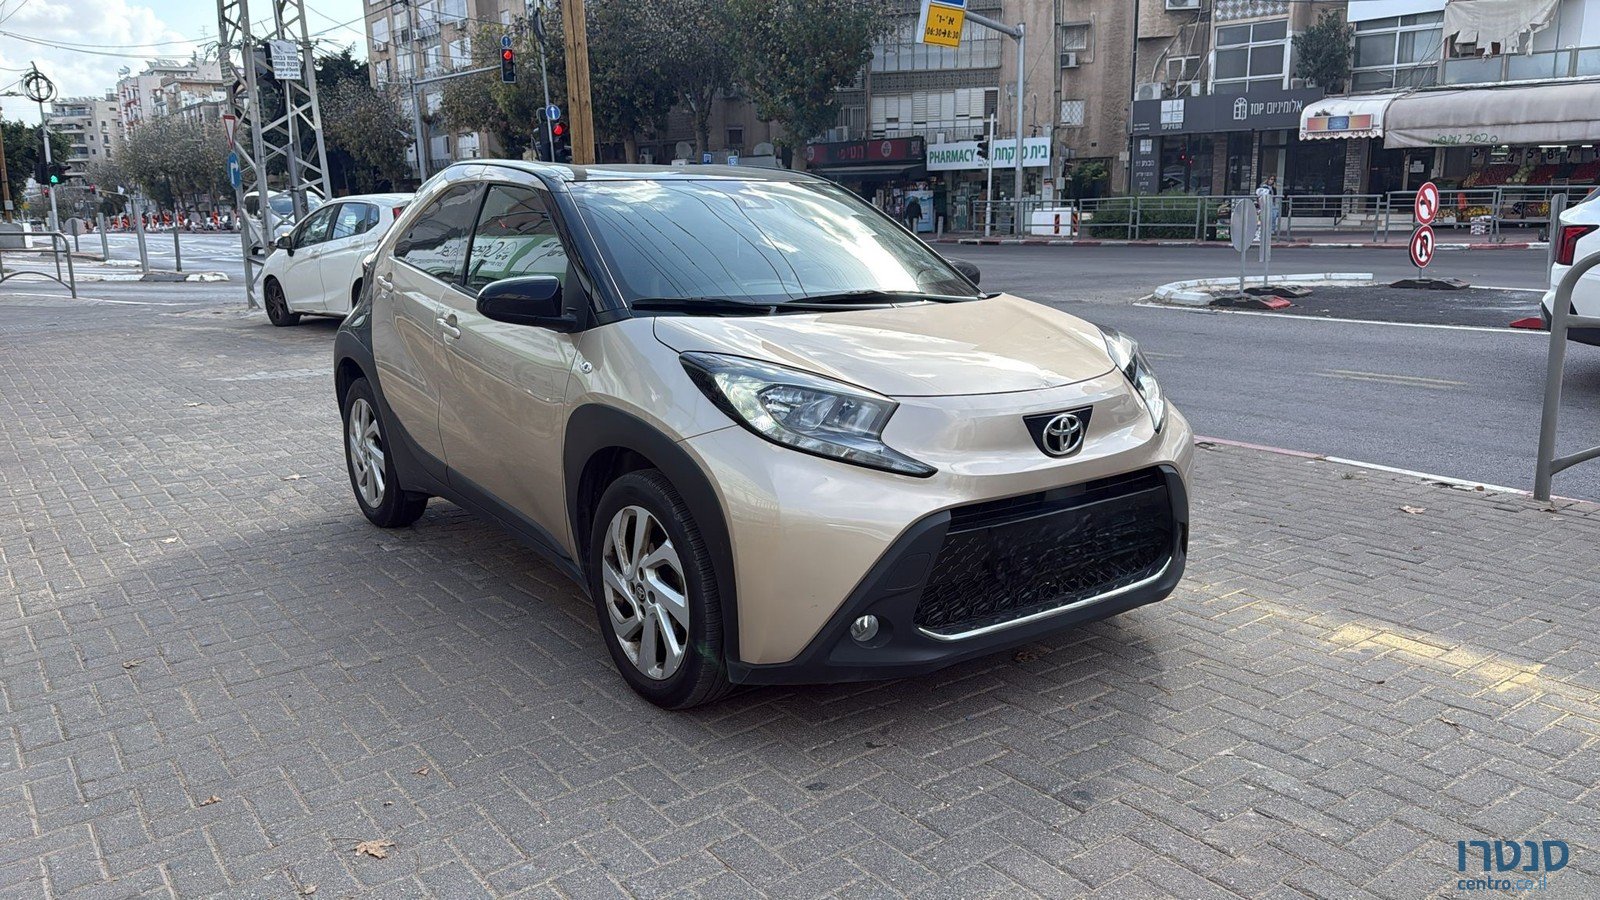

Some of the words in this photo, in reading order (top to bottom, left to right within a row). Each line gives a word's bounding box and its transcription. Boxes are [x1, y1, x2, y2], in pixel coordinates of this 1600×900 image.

[1250, 102, 1264, 115] TOP
[1266, 98, 1303, 115] אלומיניום
[929, 149, 975, 164] PHARMACY
[994, 146, 1028, 164] מקחת
[1030, 145, 1047, 159] בית
